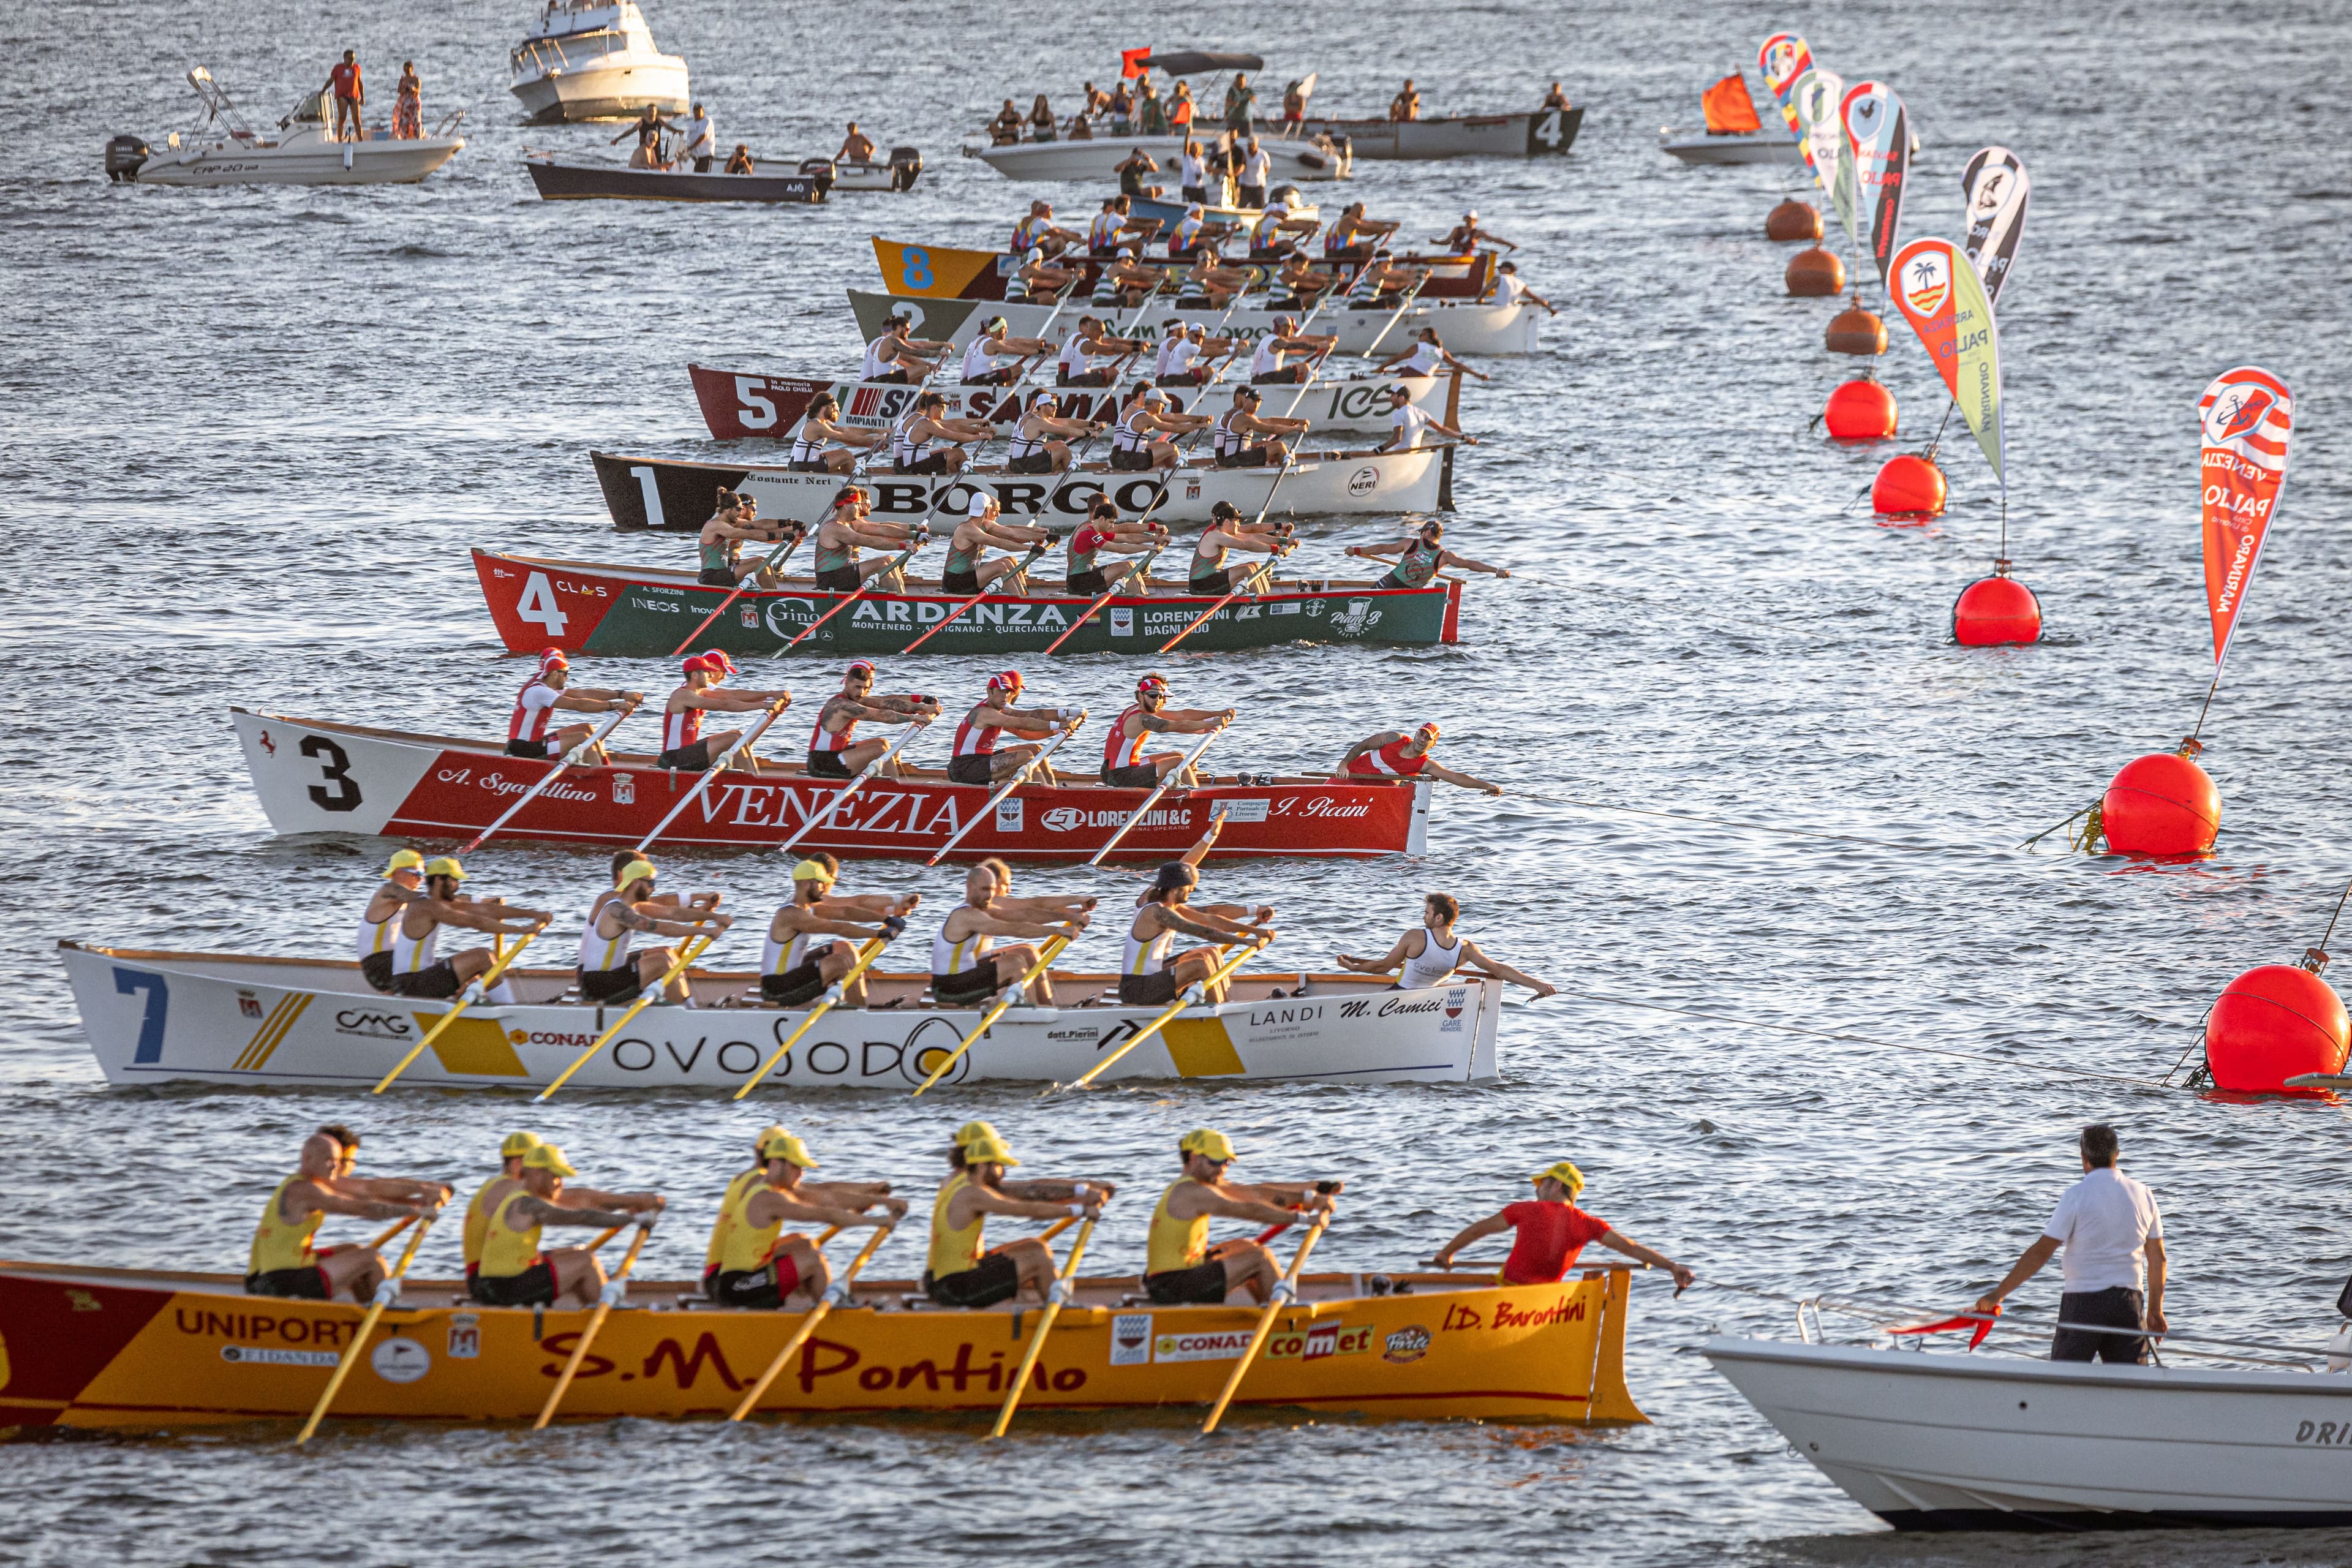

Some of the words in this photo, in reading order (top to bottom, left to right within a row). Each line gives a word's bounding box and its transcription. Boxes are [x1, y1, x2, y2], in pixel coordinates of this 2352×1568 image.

[1536, 111, 1563, 147] 4
[902, 246, 935, 290] 8
[735, 375, 777, 429] 5
[846, 416, 885, 427] IMPIANTI
[747, 474, 799, 484] Costante
[805, 477, 831, 485] Neri
[1351, 480, 1376, 490] NERI
[630, 466, 665, 525] 1
[871, 480, 1169, 516] BORGO
[556, 581, 607, 597] CLAS
[516, 571, 568, 636] 4
[632, 598, 679, 612] INEOS
[767, 603, 820, 622] Gino
[852, 600, 1068, 625] ARDENZA
[852, 621, 912, 631] MONTENERO
[995, 625, 1068, 633] QUERCIANELLA
[1145, 625, 1180, 636] BAGNI
[1330, 612, 1366, 626] Piano
[1366, 611, 1382, 624] B
[299, 735, 363, 812] 3
[698, 784, 960, 836] VENEZIA
[111, 967, 168, 1064] 7
[1250, 1006, 1322, 1026] LANDI
[1340, 1000, 1371, 1018] M.
[1378, 997, 1444, 1017] Camici
[1491, 1295, 1586, 1330] Barontini
[1270, 1325, 1371, 1356] comet
[796, 1336, 1087, 1393] Pontino
